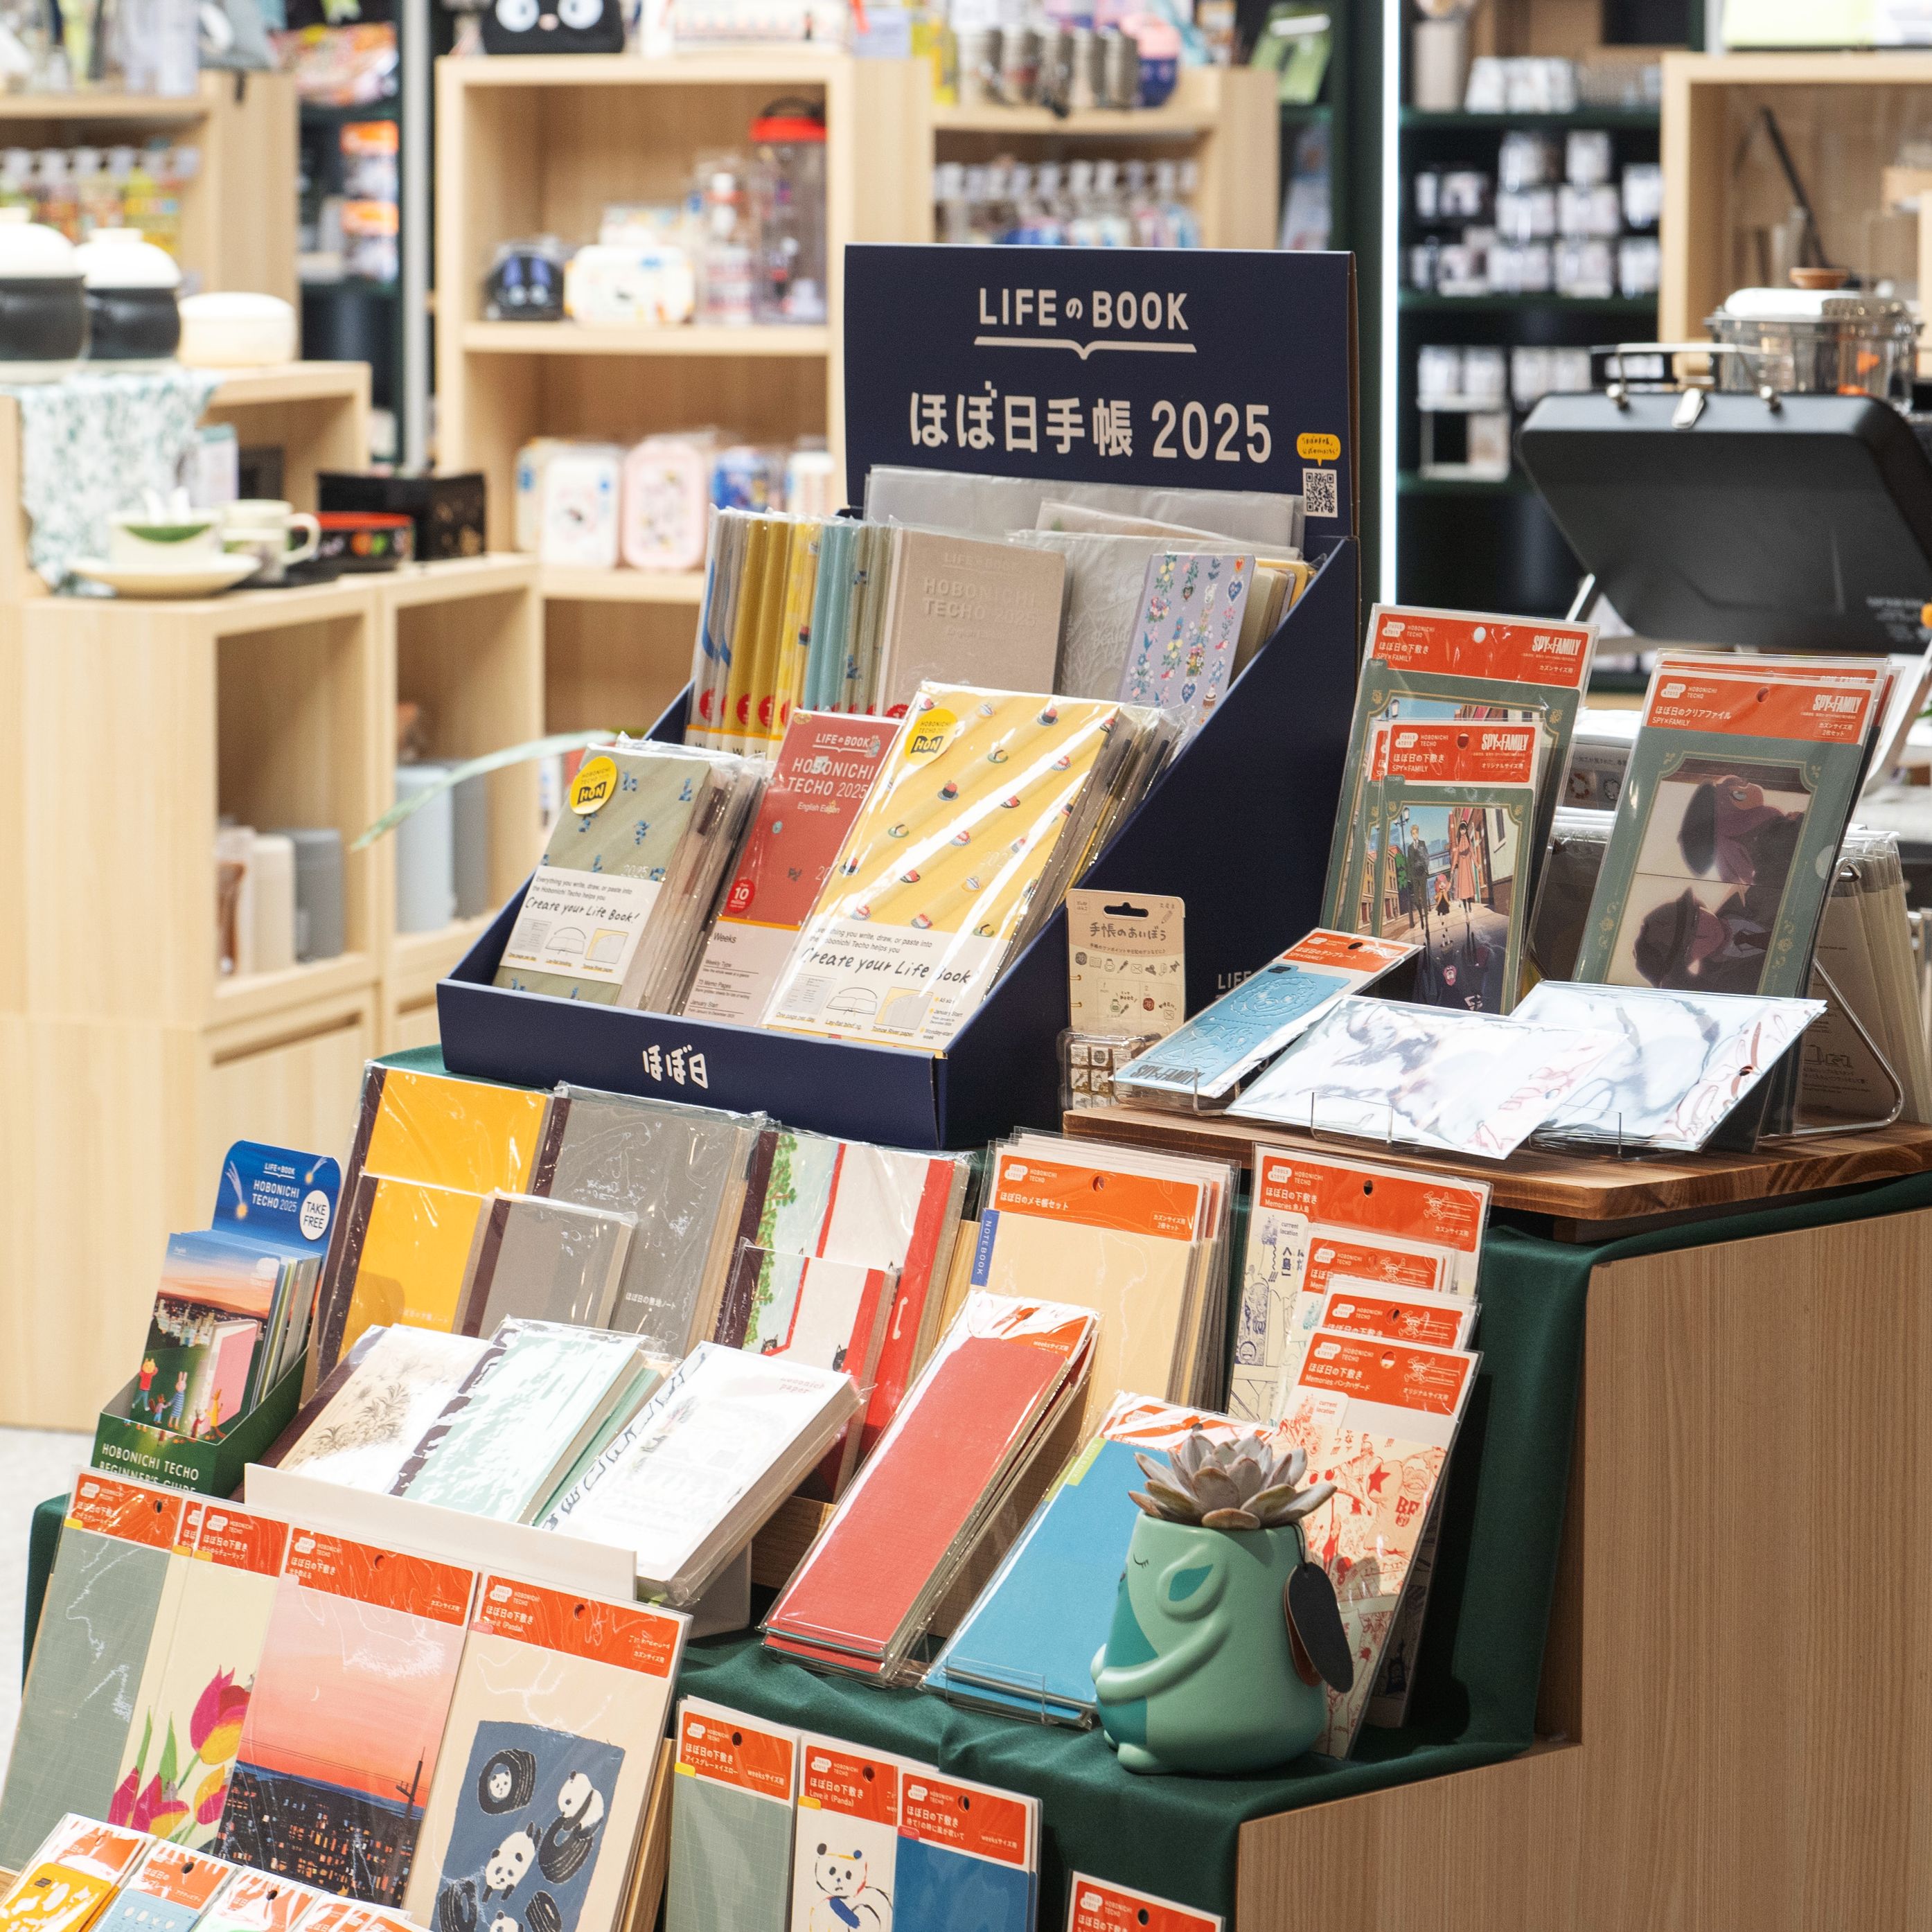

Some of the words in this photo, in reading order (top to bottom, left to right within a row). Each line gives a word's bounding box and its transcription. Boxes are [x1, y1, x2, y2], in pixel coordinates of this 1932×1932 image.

[979, 287, 1057, 326] LIFE
[1065, 297, 1083, 320] の
[1092, 291, 1189, 330] BOOK
[910, 381, 1133, 457] ほぼ日手帳
[1151, 400, 1272, 463] 2025
[1379, 641, 1429, 654] ほぼ日の下敷き
[1655, 706, 1732, 720] ほぼ日のクリアファイル
[815, 733, 838, 745] LIFE
[844, 736, 871, 747] BOOK
[1393, 753, 1445, 763] ほぼ日の下敷き
[791, 757, 875, 781] HOBONICHI
[787, 777, 833, 796] TECHO
[836, 781, 869, 799] 2025
[797, 801, 820, 813] English
[620, 865, 649, 879] 2025
[734, 887, 750, 901] 10
[525, 896, 559, 912] Create
[562, 903, 584, 915] your
[585, 905, 607, 917] Life
[713, 932, 737, 944] Weeks
[1090, 922, 1167, 941] 手帳のあいぼう
[855, 958, 892, 973] your
[894, 961, 930, 978] Life
[642, 1044, 709, 1089] ほぼ日
[265, 1162, 277, 1172] LIFE
[1293, 1171, 1324, 1181] HOBONICHI
[254, 1180, 300, 1198] HOBONICHI
[1293, 1178, 1311, 1186] TECHO
[252, 1194, 279, 1209] TECHO
[279, 1199, 298, 1213] 2025
[1000, 1192, 1069, 1211] ほぼ日のメモ帳セット
[1264, 1199, 1293, 1210] Memories
[1265, 1187, 1318, 1205] ほぼ日の下敷き
[306, 1201, 327, 1216] TAKE
[303, 1214, 325, 1230] FREE
[1281, 1221, 1300, 1230] current
[1279, 1229, 1299, 1237] location
[977, 1220, 993, 1275] NOTEBOOK
[1304, 1374, 1334, 1386] Memories
[1308, 1363, 1363, 1381] ほぼ日の下敷き
[102, 1443, 161, 1470] HOBONICHI
[163, 1460, 200, 1481] TECHO
[203, 1534, 248, 1552] ほぼ日の下敷き
[291, 1557, 337, 1576] ほぼ日の下敷き
[486, 1605, 533, 1625] ほぼ日の下敷き
[685, 1742, 734, 1764] ほぼ日の下敷き
[809, 1777, 864, 1799] ほぼ日の下敷き
[809, 1789, 824, 1800] Love
[906, 1805, 959, 1829] ほぼ日の下敷き
